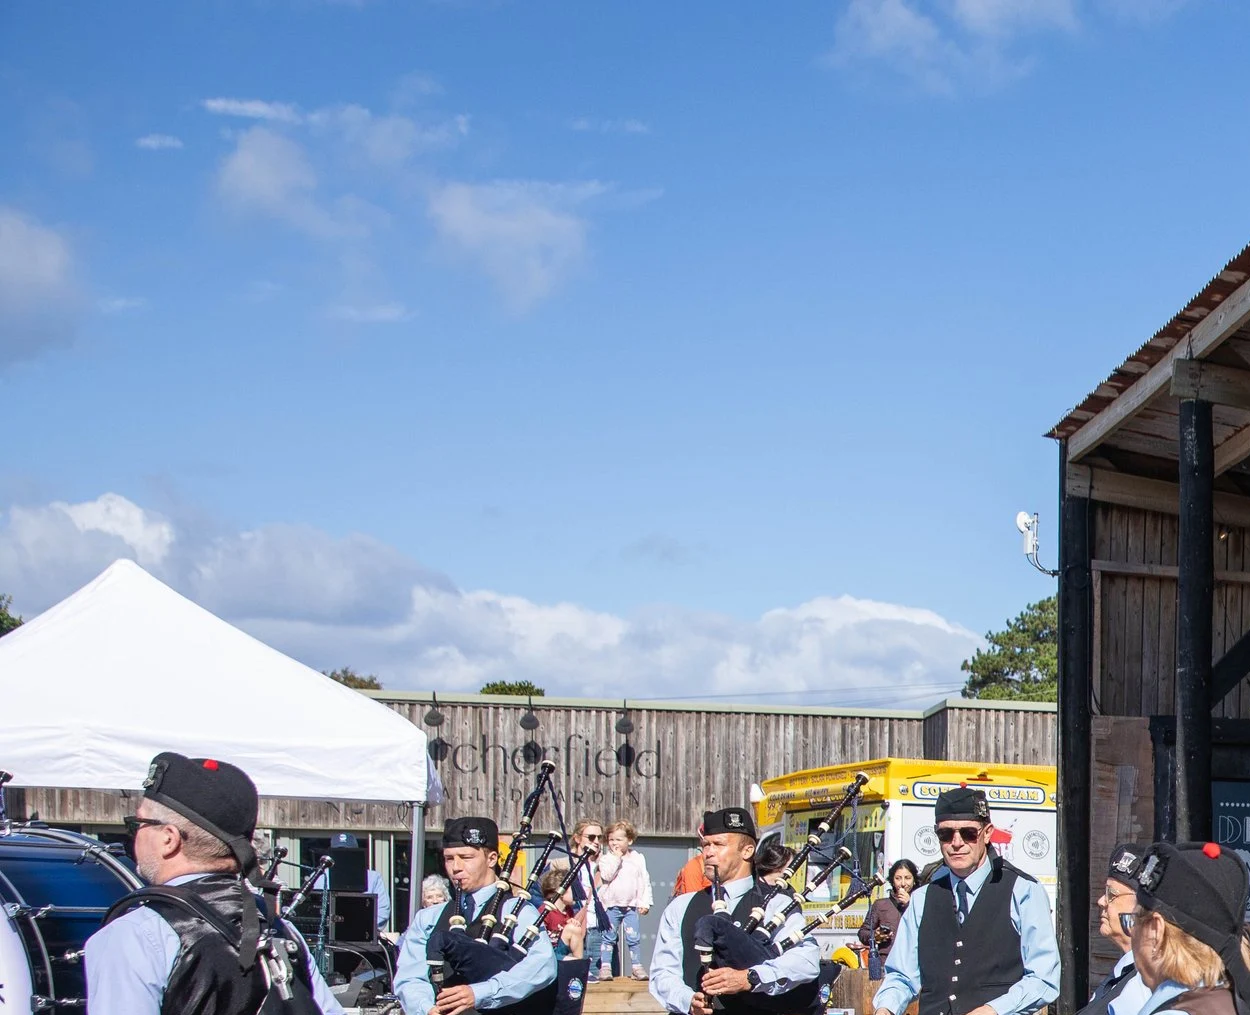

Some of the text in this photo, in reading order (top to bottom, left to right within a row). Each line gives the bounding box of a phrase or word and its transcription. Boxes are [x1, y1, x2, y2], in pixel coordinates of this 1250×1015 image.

[432, 734, 662, 779] rcherfield
[443, 787, 522, 802] ALLED
[988, 789, 1039, 801] CREAM
